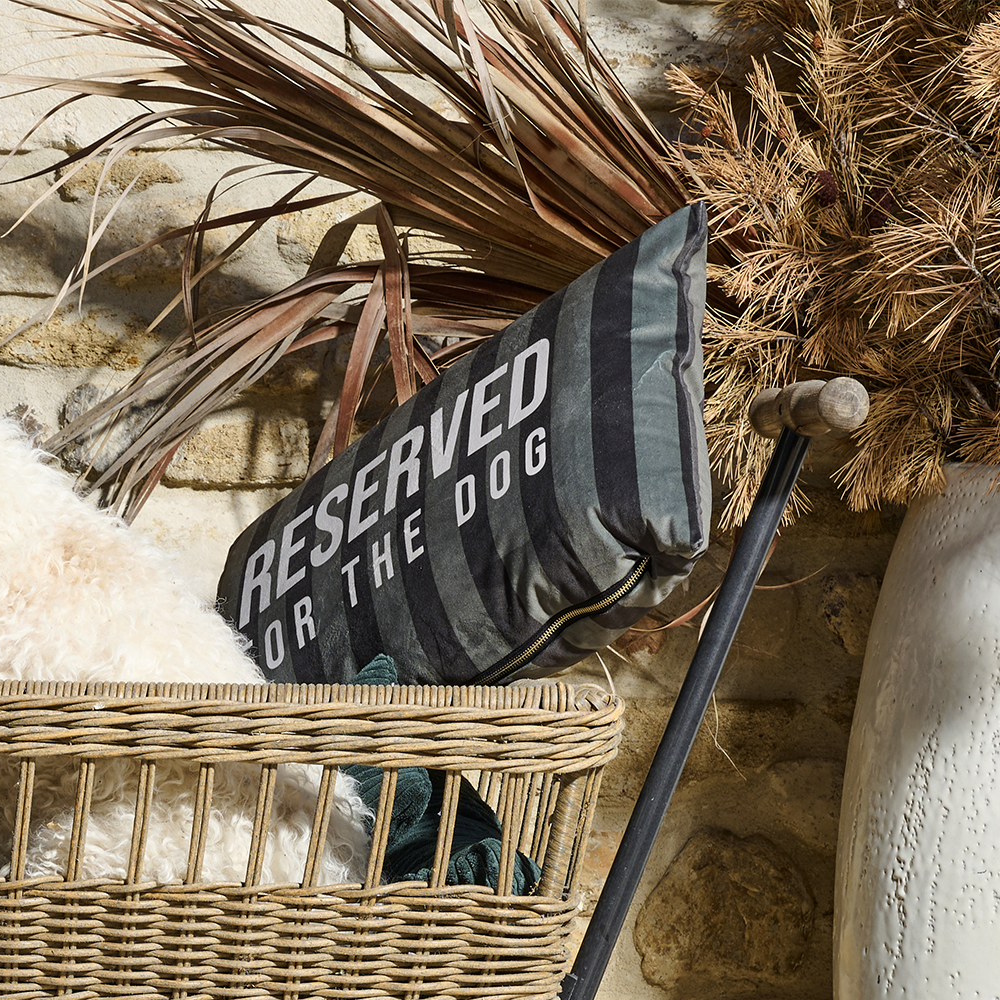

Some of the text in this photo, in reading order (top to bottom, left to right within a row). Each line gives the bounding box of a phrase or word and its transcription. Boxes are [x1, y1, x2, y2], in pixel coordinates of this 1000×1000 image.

[239, 338, 551, 631] RESERVED
[241, 427, 547, 670] OR THE DOG
